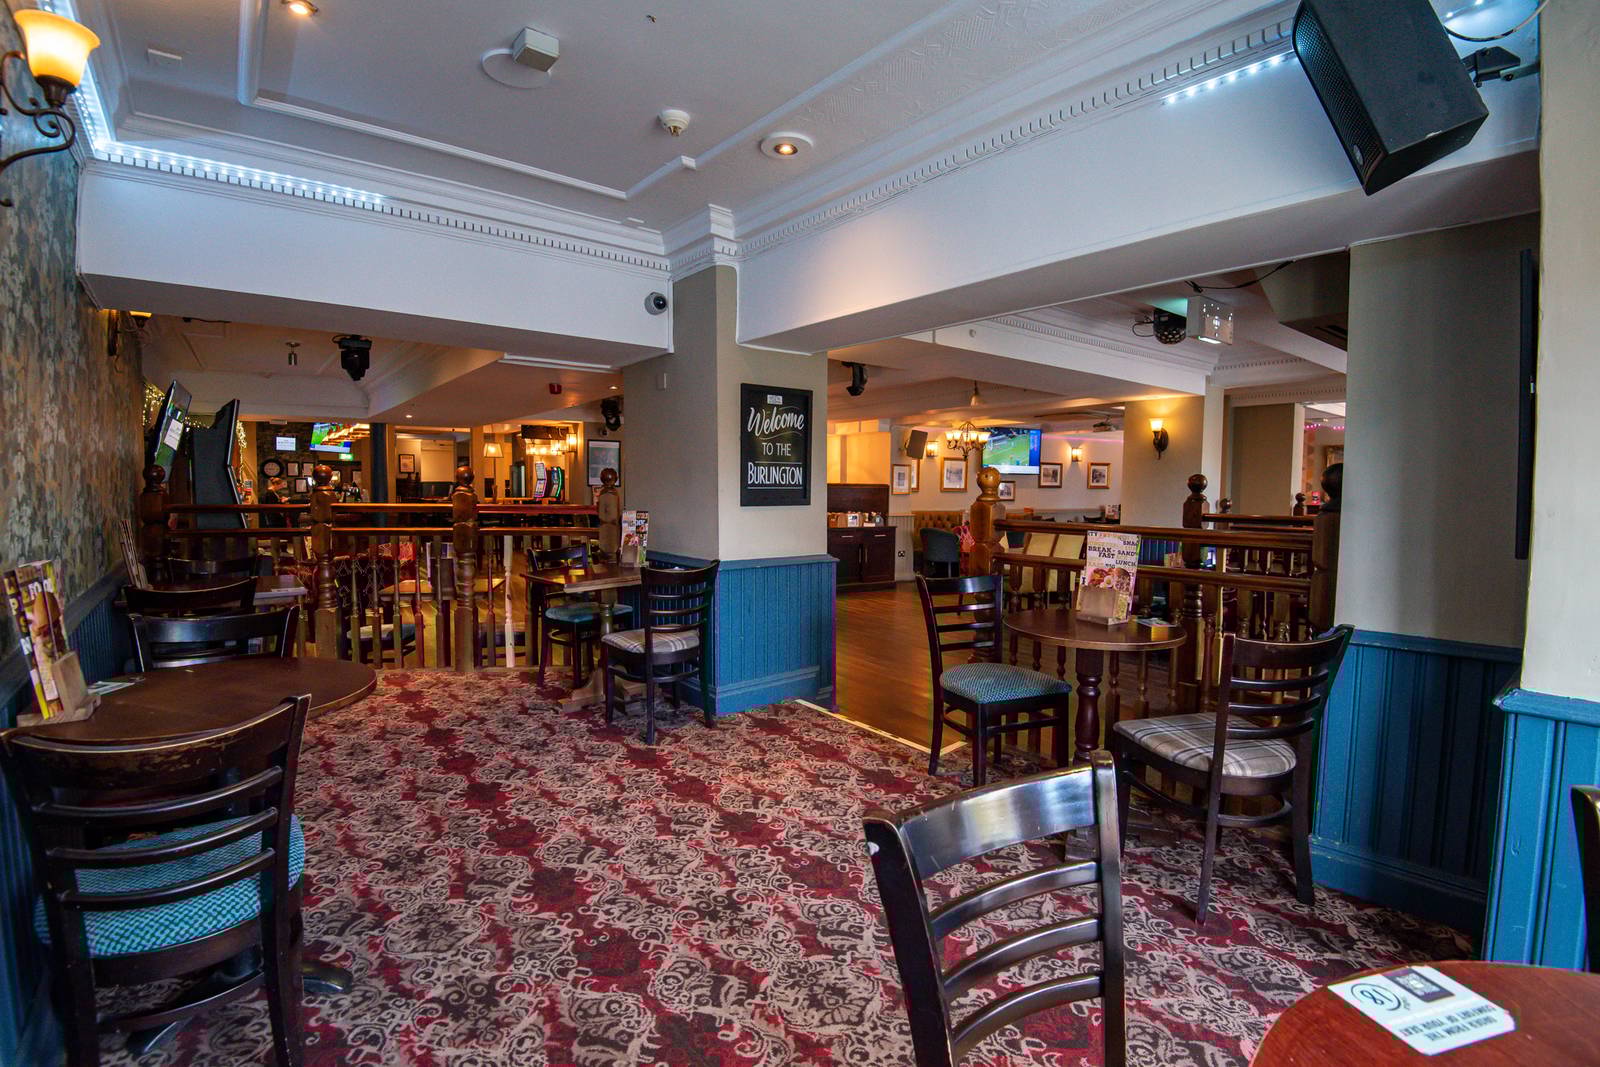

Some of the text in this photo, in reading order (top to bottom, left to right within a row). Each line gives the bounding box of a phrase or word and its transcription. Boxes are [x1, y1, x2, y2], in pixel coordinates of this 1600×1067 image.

[747, 406, 804, 436] Welcome
[762, 442, 792, 456] TO THE
[748, 462, 802, 485] BURLINGTON
